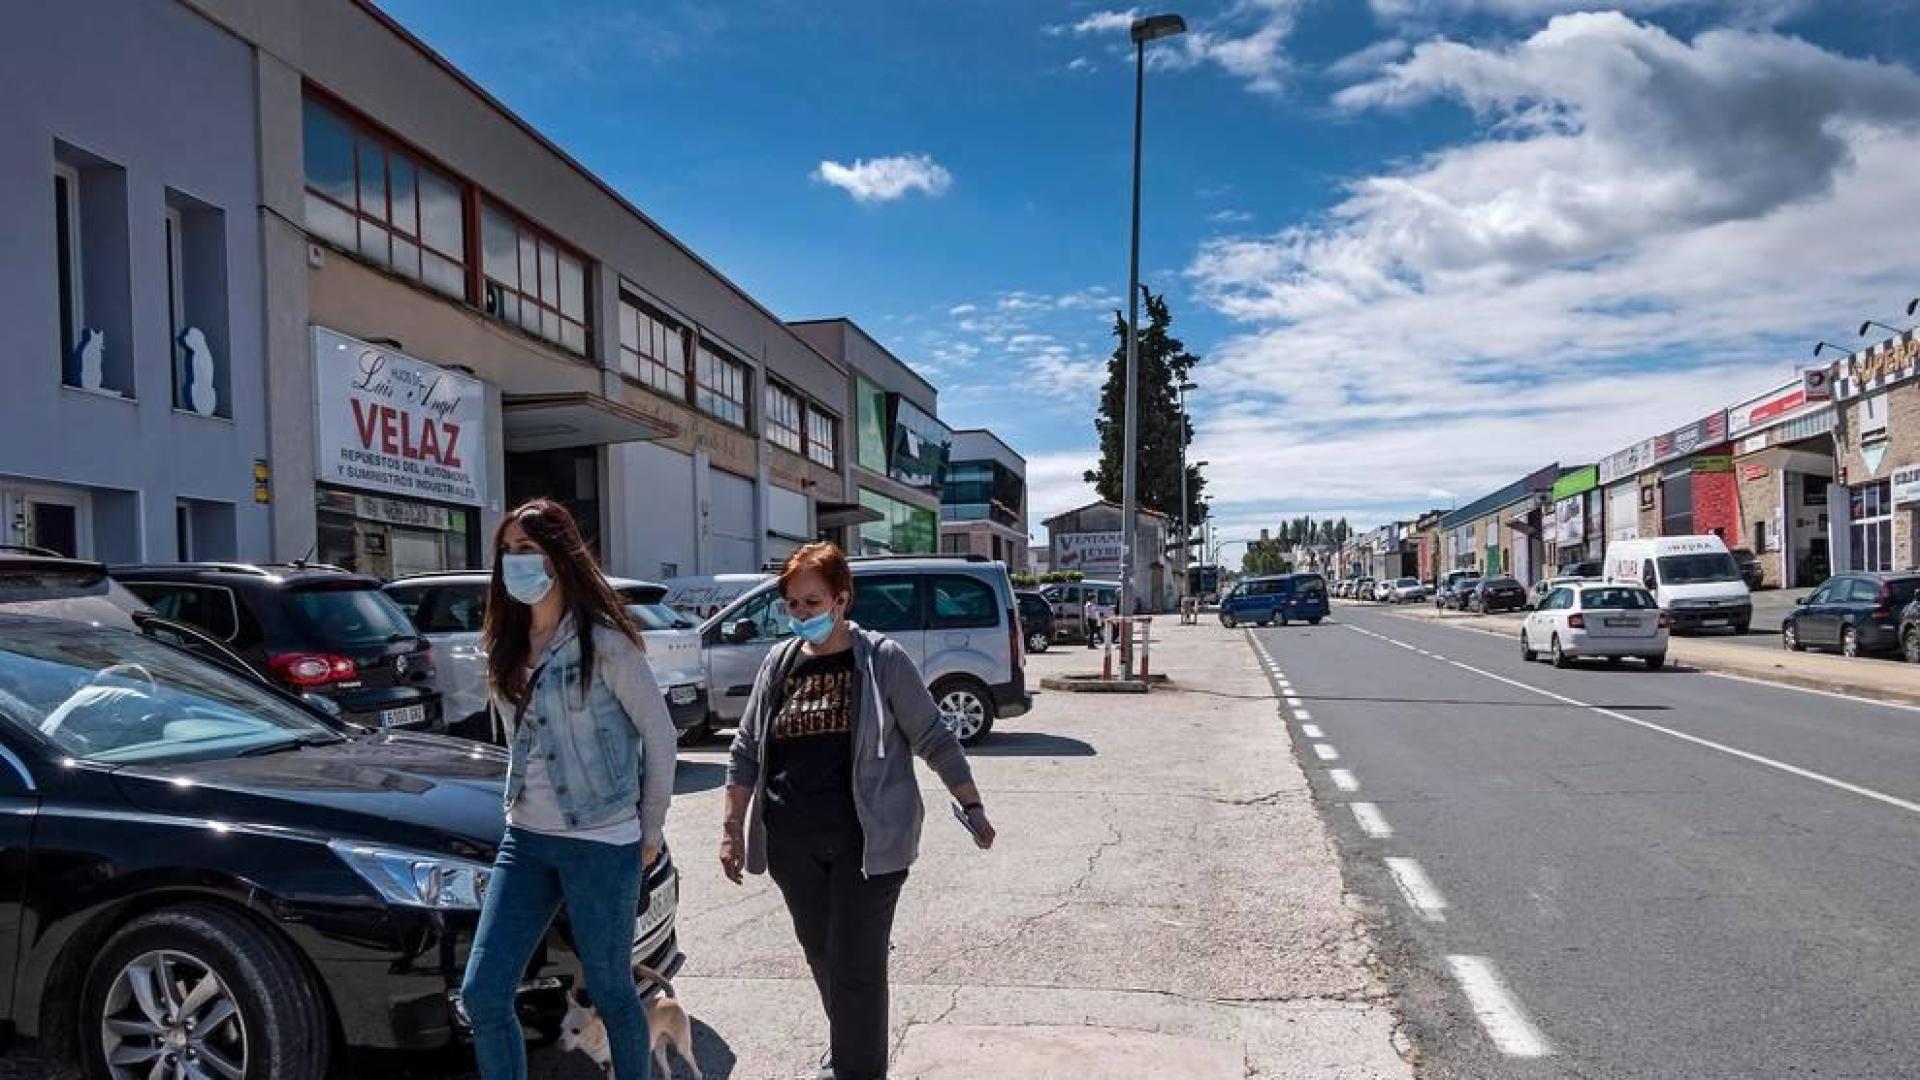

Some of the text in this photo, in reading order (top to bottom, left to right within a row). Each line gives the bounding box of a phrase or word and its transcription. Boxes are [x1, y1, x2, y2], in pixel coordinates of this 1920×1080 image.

[352, 350, 392, 398] Luis
[350, 397, 461, 468] VELAZ
[337, 464, 476, 498] Y SUMINISTROS INDUSTRIALES
[341, 447, 400, 470] REPUESTOS
[402, 460, 420, 474] DEL
